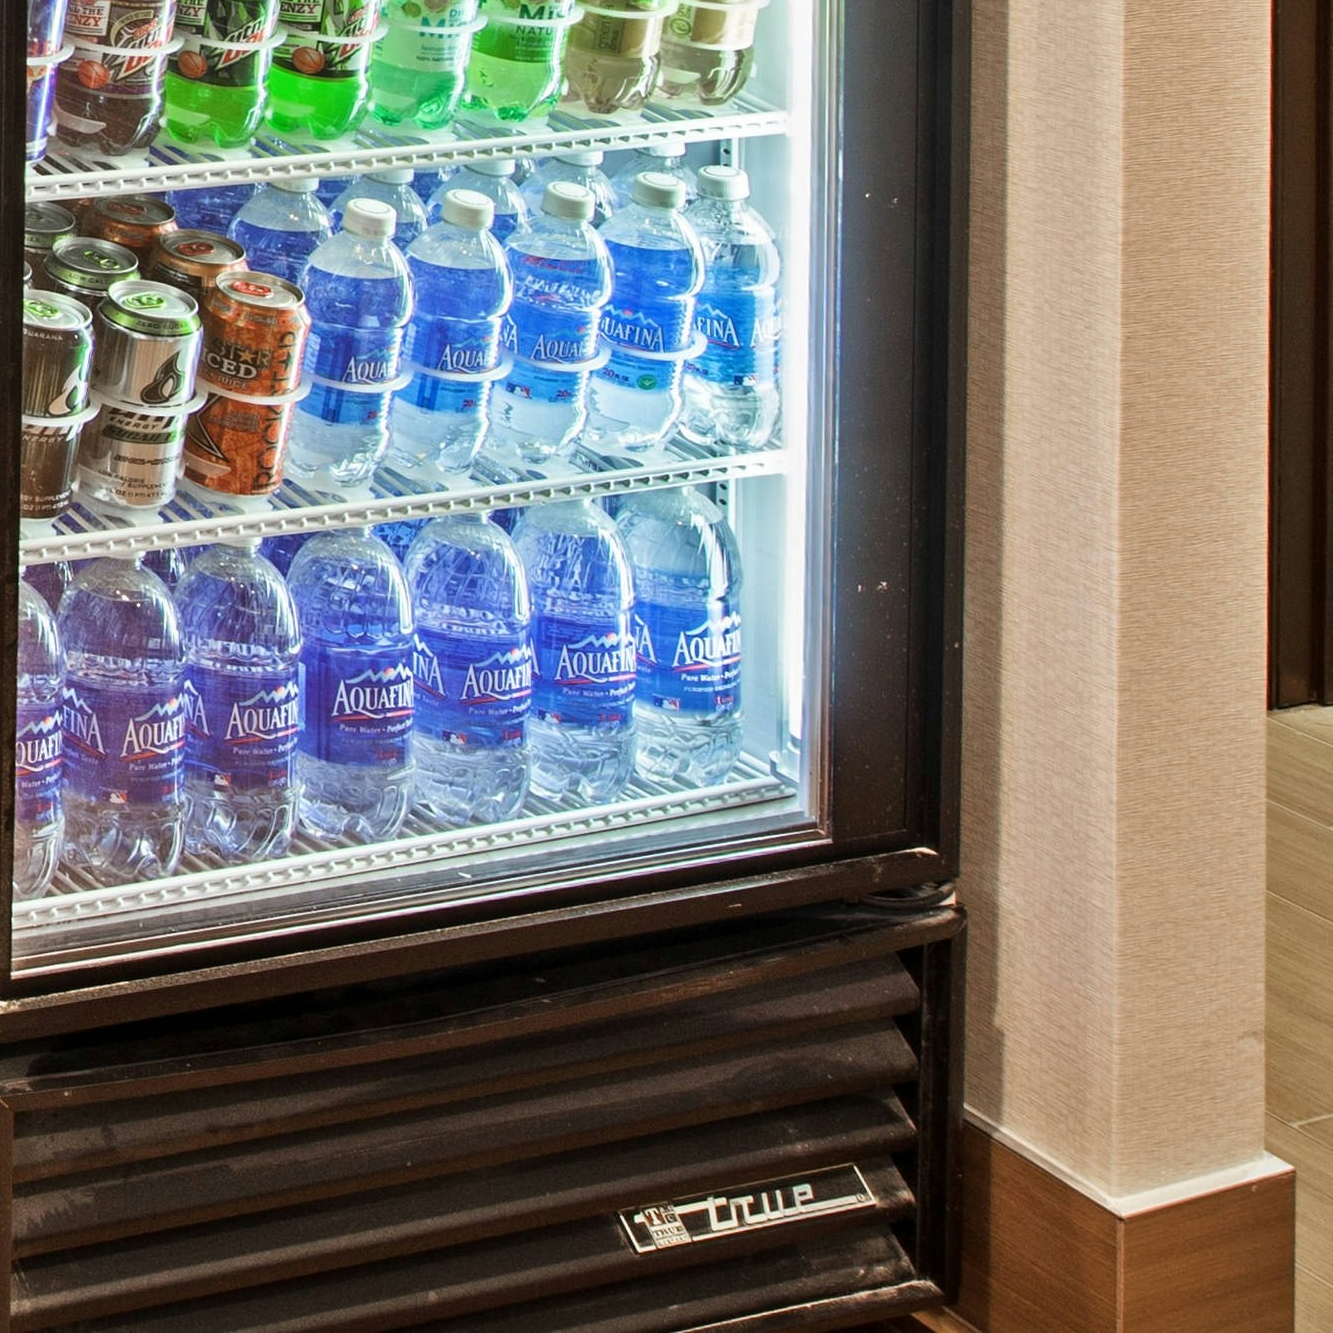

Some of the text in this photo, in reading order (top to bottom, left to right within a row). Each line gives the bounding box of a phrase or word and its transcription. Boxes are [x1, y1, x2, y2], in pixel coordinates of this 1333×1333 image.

[554, 643, 636, 683] AQUAFIN
[681, 672, 721, 682] Pure Water
